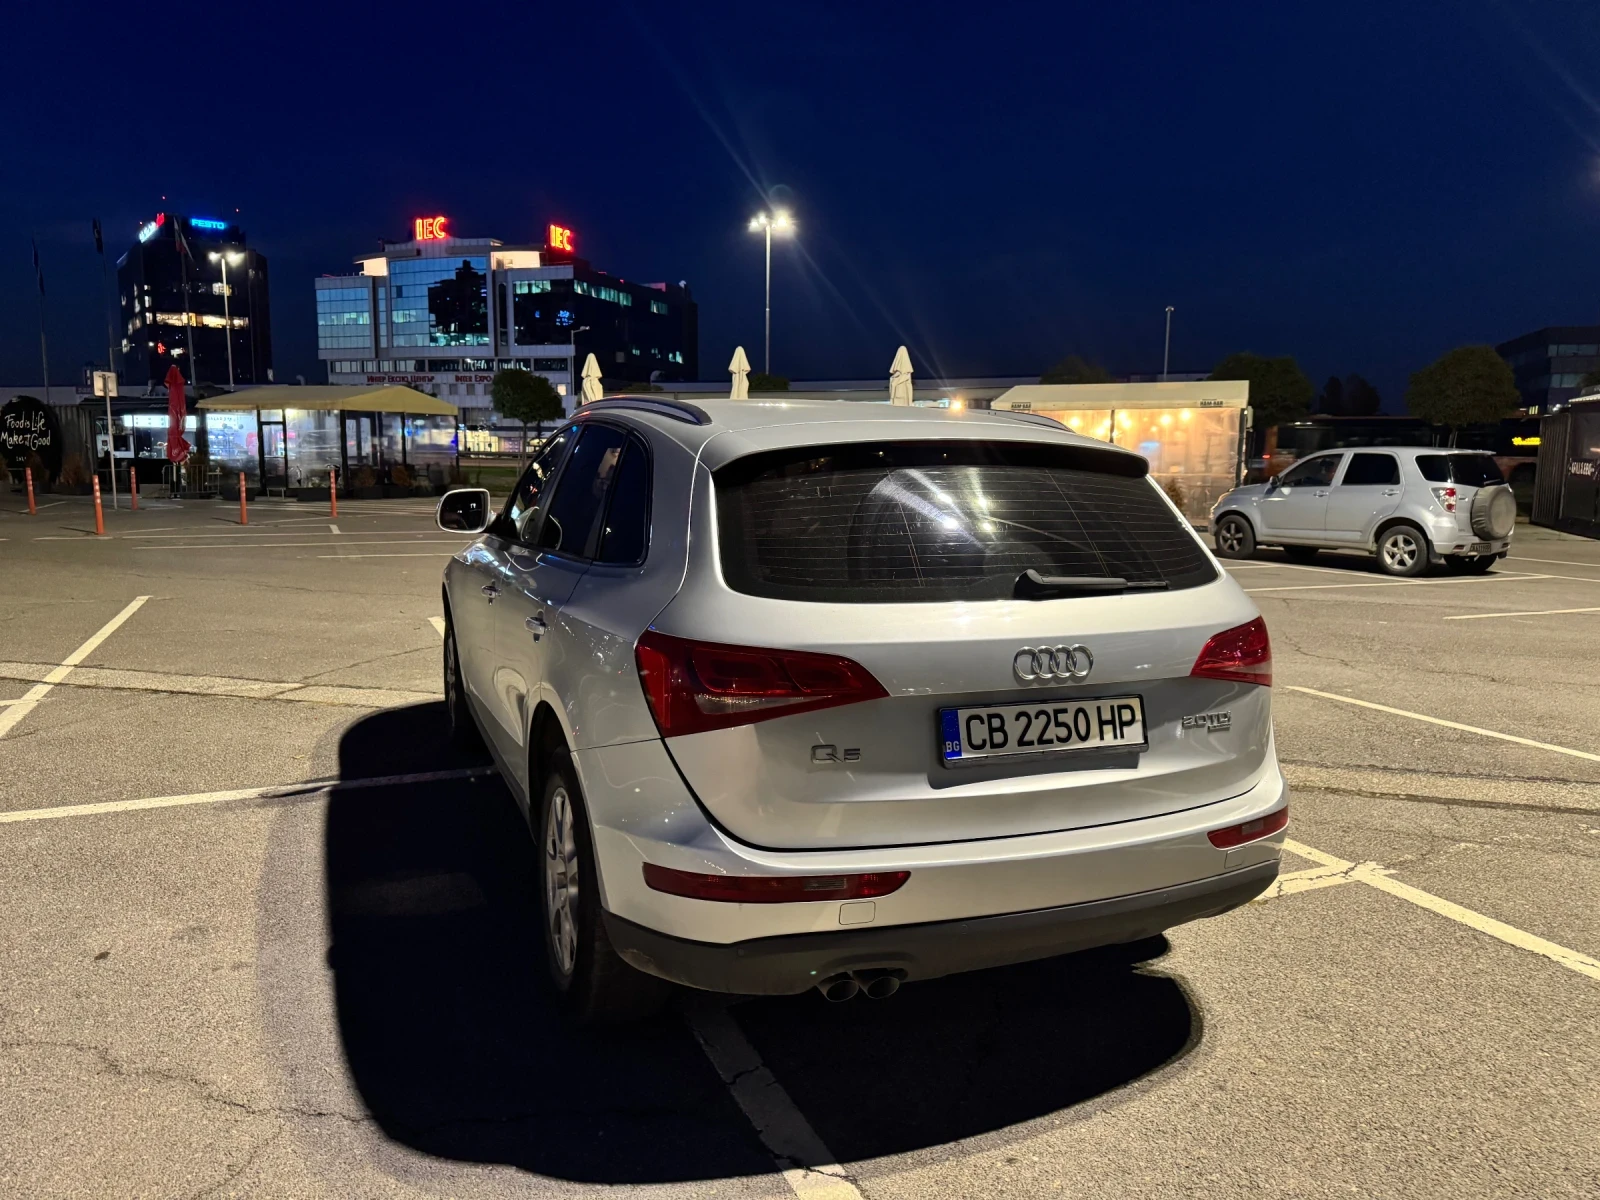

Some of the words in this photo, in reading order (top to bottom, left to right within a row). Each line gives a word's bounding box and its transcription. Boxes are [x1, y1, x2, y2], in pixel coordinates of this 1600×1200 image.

[191, 218, 225, 230] FESTO
[415, 216, 447, 240] IEC
[549, 224, 572, 251] IEC
[4, 411, 25, 429] Food
[31, 410, 46, 433] Life
[0, 430, 24, 449] Make
[31, 429, 51, 451] Good
[965, 713, 1009, 751] CB
[1014, 706, 1091, 748] 2250
[1096, 703, 1136, 741] HP
[811, 744, 861, 764] Q5
[945, 740, 960, 752] BG
